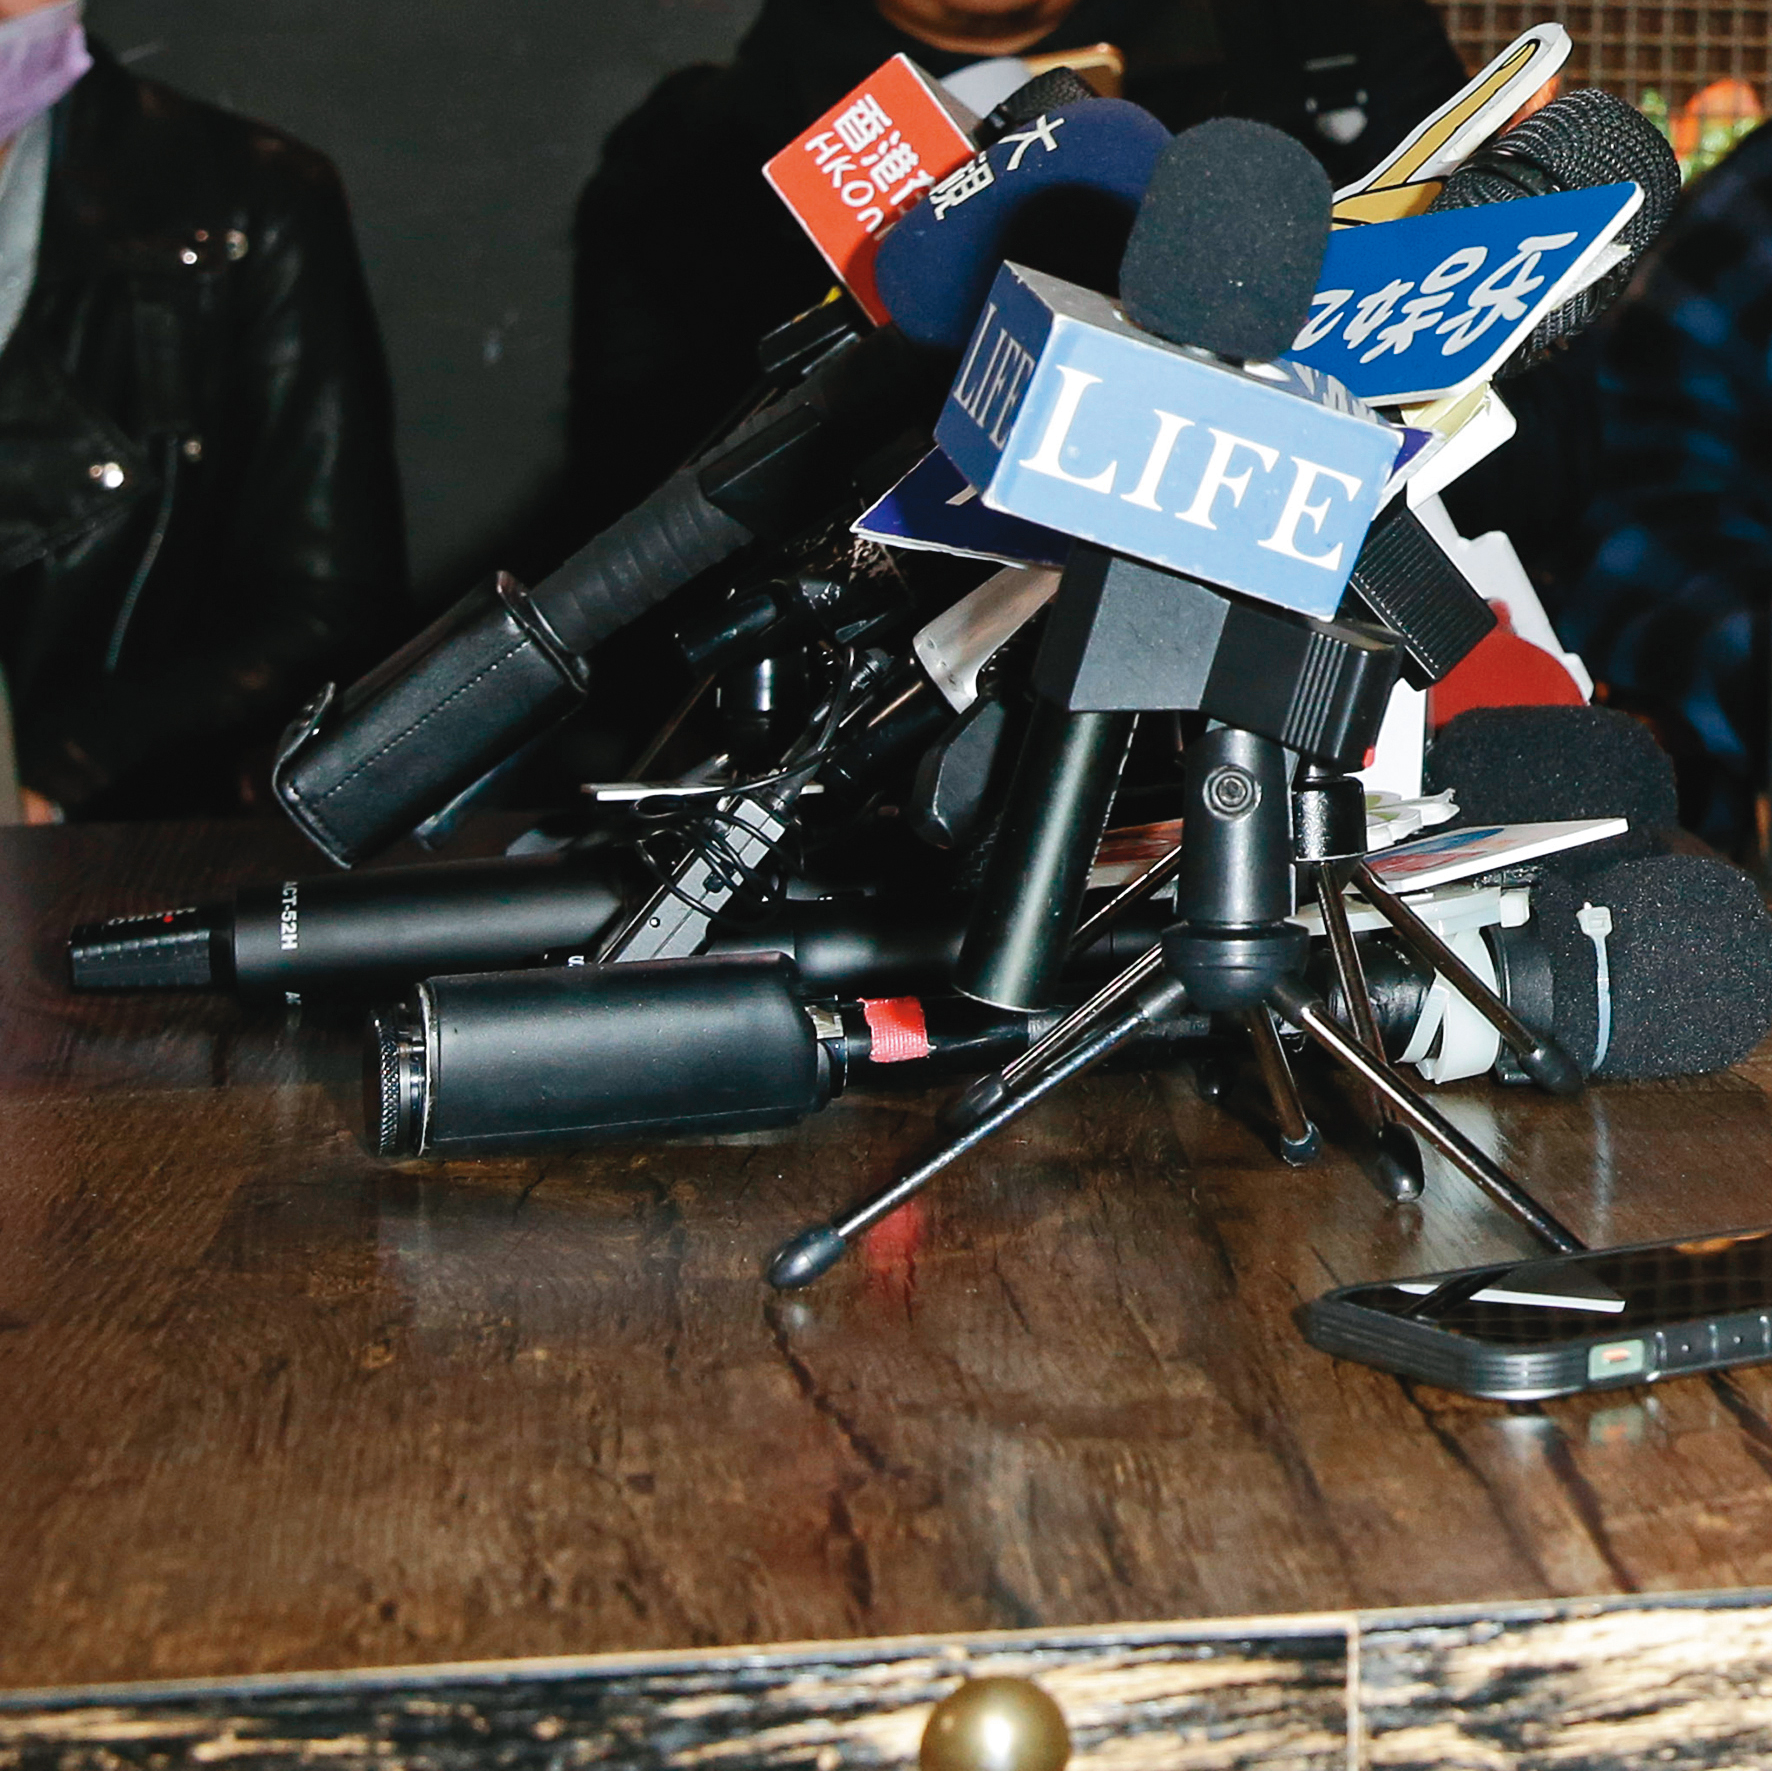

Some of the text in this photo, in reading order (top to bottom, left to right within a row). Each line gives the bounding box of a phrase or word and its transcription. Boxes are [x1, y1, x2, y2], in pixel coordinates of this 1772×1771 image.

[953, 302, 1037, 450] LIFE
[1019, 364, 1363, 571] LIFE
[281, 880, 299, 951] ACT-52H
